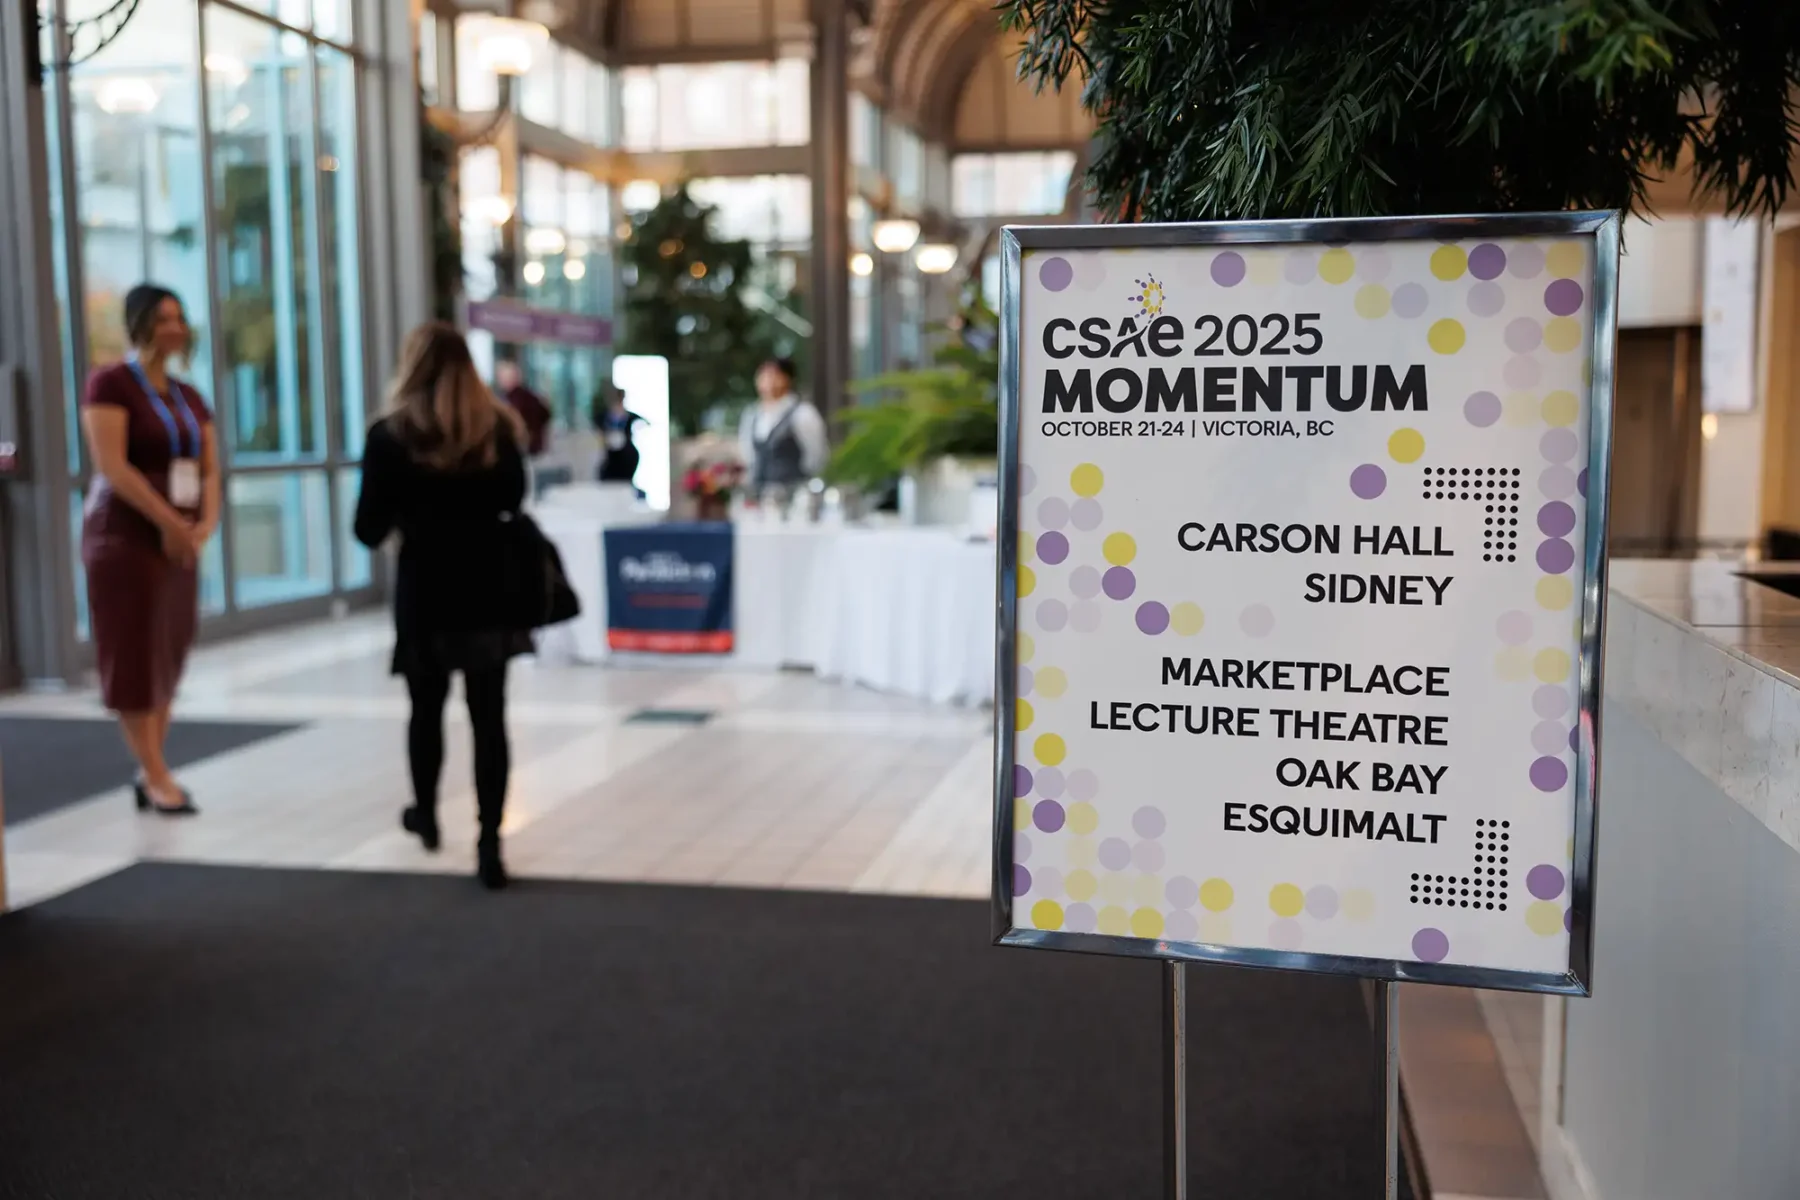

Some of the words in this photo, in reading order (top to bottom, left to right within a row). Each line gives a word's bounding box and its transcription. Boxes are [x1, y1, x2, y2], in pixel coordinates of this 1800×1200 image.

[1194, 313, 1323, 356] 2025
[1042, 365, 1428, 413] MOMENTUM
[1041, 420, 1133, 437] OCTOBER
[1137, 420, 1185, 437] 21-24
[1202, 420, 1301, 439] VICTORIA,
[1306, 420, 1334, 437] BC
[1178, 523, 1340, 553] CARSON
[1354, 525, 1453, 556] HALL
[1304, 573, 1454, 605] SIDNEY
[1162, 657, 1450, 696] MARKETPLACE
[1091, 701, 1259, 736] LECTURE
[1270, 709, 1448, 746] THEATRE
[1276, 758, 1360, 790] OAK
[1372, 763, 1448, 794] BAY
[1224, 803, 1447, 843] ESQUIMALT
